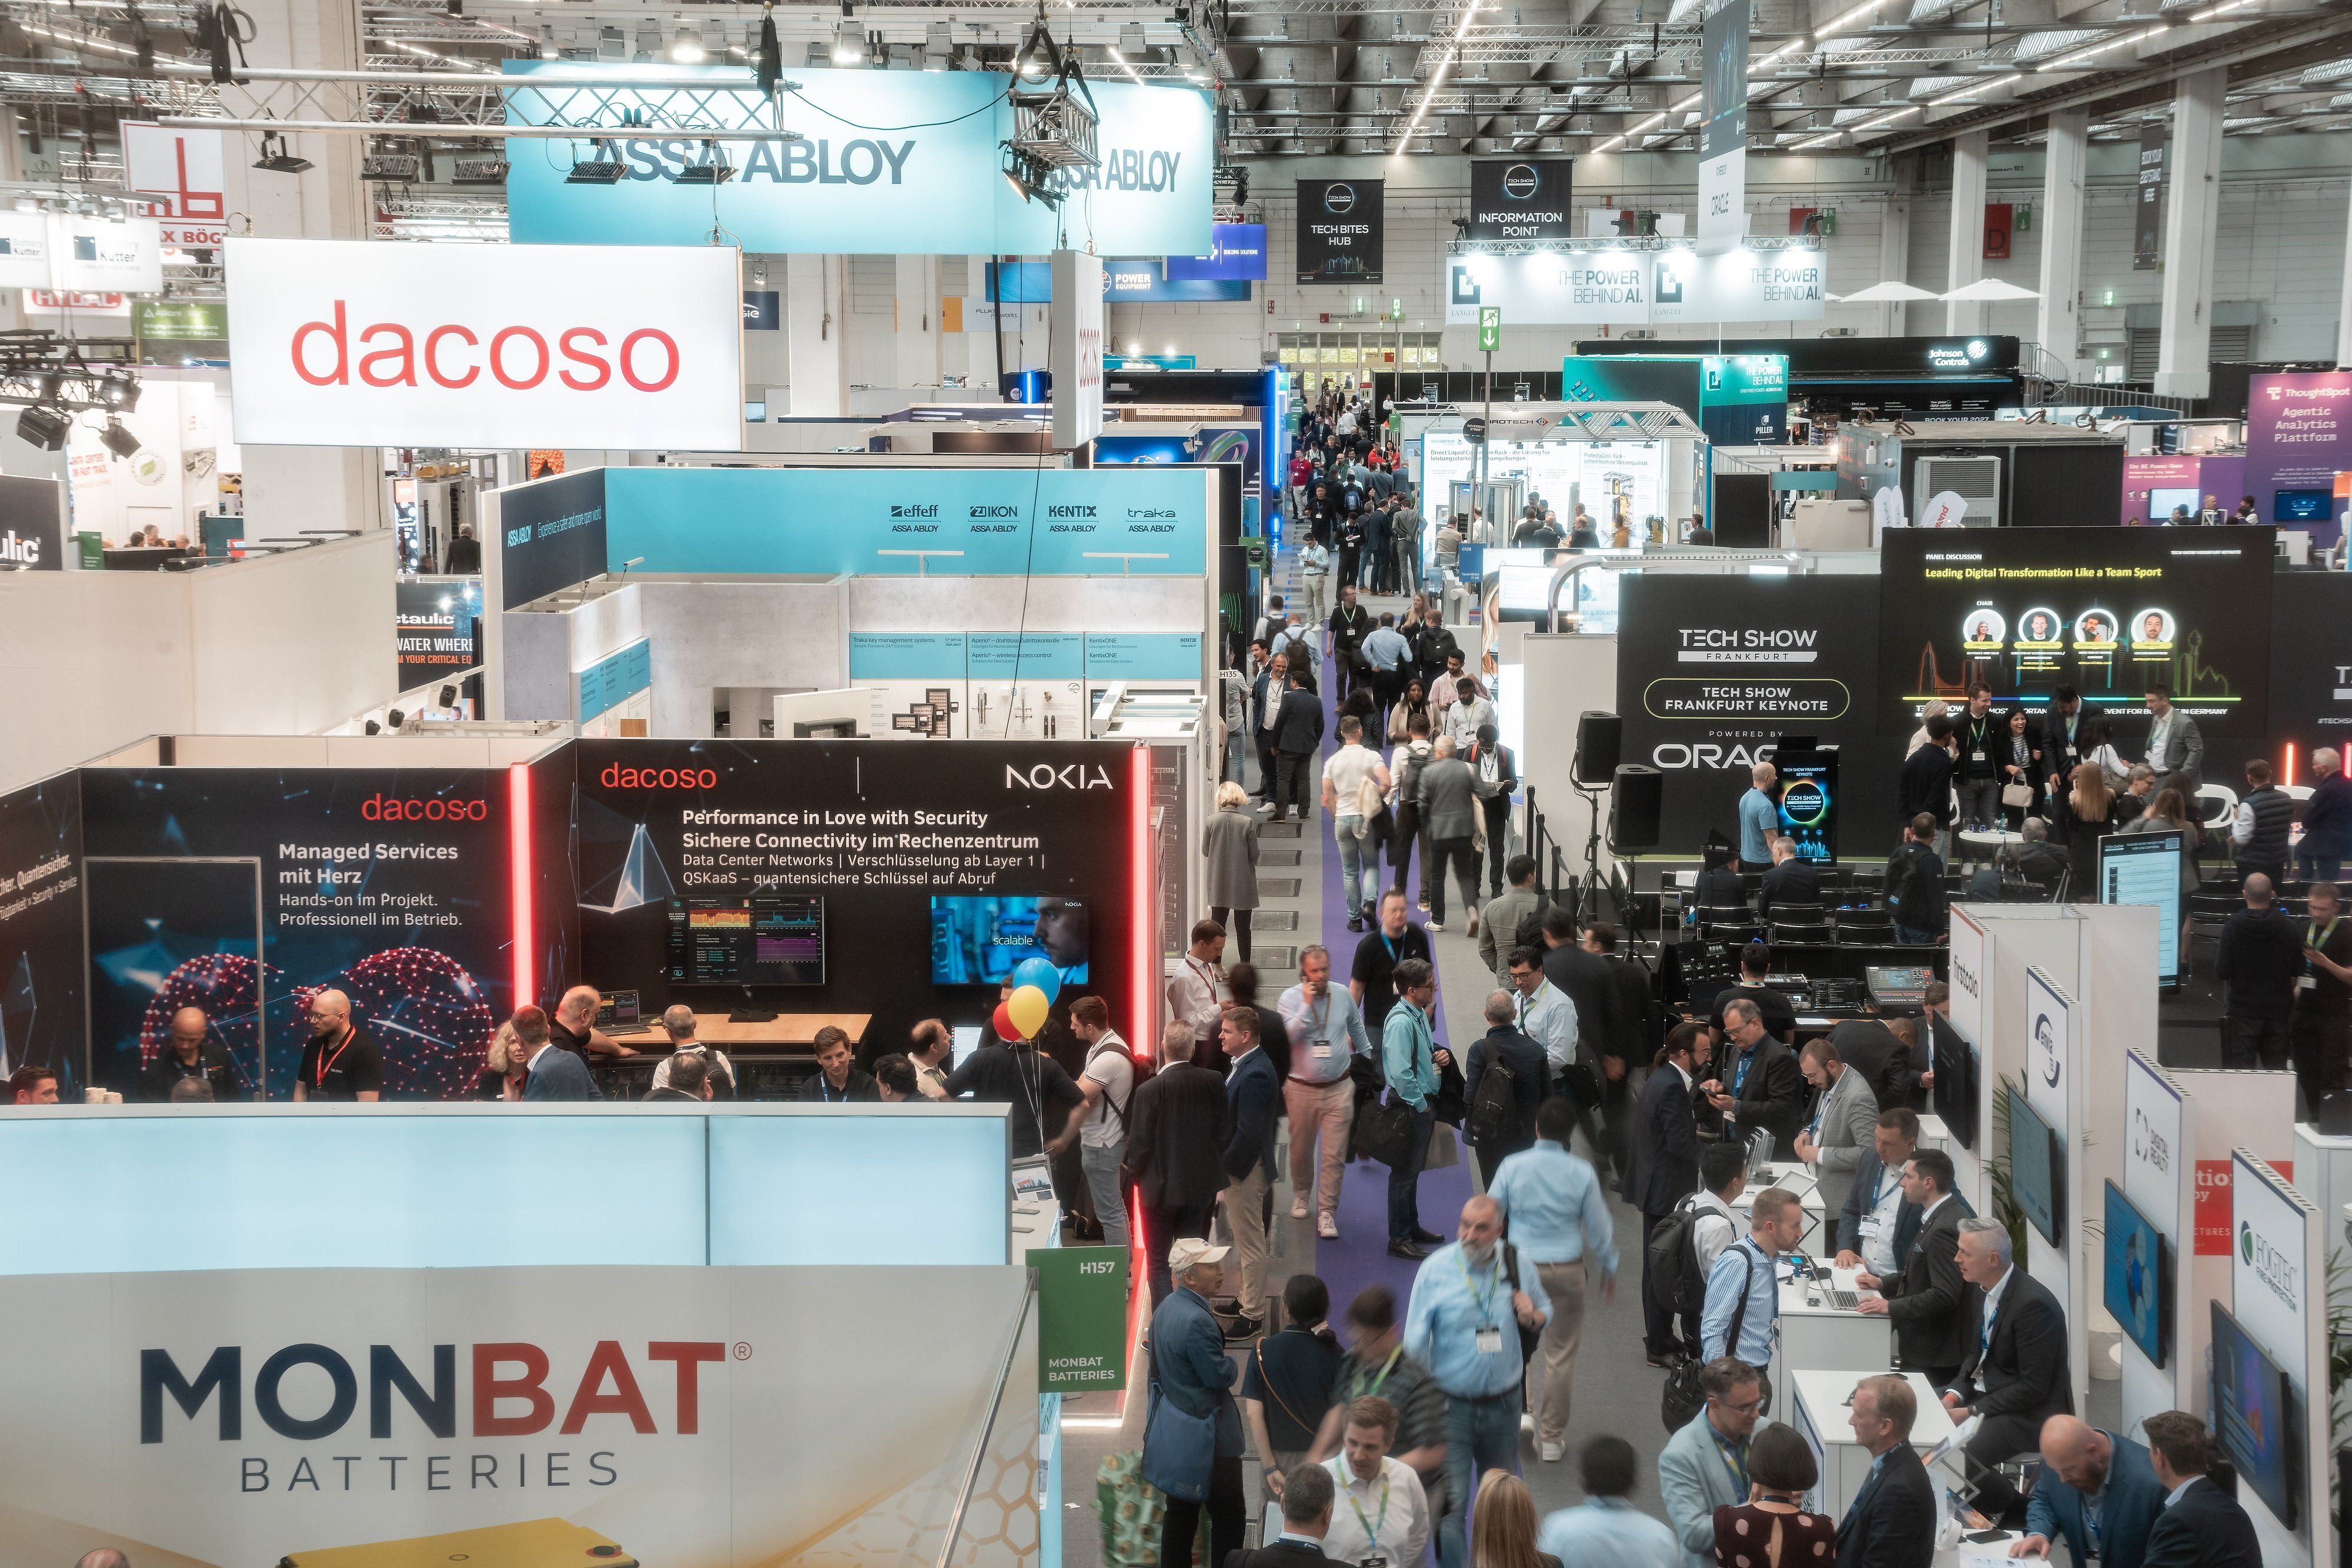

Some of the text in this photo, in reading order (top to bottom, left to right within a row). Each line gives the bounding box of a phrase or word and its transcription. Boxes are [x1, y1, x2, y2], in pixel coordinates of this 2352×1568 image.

[741, 139, 916, 185] ABLOY
[1105, 149, 1181, 192] ABLOY
[1712, 192, 1729, 216] ORACLE
[1479, 212, 1562, 223] INFORMATION
[1311, 225, 1369, 234] TECH BITES
[1503, 226, 1539, 236] POINT
[1329, 237, 1351, 245] HUB
[1988, 229, 2005, 250] D
[100, 252, 136, 262] Kutter
[1115, 273, 1151, 283] POWER
[1558, 270, 1639, 286] THE POWER
[1750, 268, 1818, 283] THE POWER
[1574, 288, 1643, 303] BEHIND AI.
[1765, 286, 1820, 301] BEHIND AI.
[291, 299, 680, 392] dacoso
[1079, 306, 1100, 388] dacoso
[1928, 349, 1963, 358] Johnson
[1935, 357, 1969, 366] Controls
[1745, 366, 1782, 376] THE POWER
[1753, 376, 1775, 385] BEHIND
[2285, 387, 2351, 399] ThoughtSpot
[2283, 407, 2331, 417] Agentic
[1756, 426, 1773, 434] PILLER
[2276, 420, 2337, 430] Analytics
[2274, 433, 2337, 442] Plattform
[904, 505, 939, 517] effeff
[988, 506, 1018, 517] IKON
[1049, 506, 1097, 517] KENTIX
[1128, 508, 1176, 517] traka
[575, 514, 584, 526] more
[584, 511, 593, 526] open
[508, 529, 519, 547] ASSA
[1926, 568, 1963, 579] Leading
[1966, 568, 1996, 579] Digital
[1999, 568, 2073, 577] Transformation
[2075, 568, 2095, 577] Like
[2105, 567, 2132, 577] Team
[2134, 567, 2162, 579] Sport
[1678, 629, 1818, 647] TECH SHOW
[406, 655, 460, 664] YOUR CRITICAL
[1703, 687, 1791, 697] TECH SHOW
[1665, 700, 1828, 711] FRANKFURT KEYNOTE
[601, 763, 717, 788] dacoso
[1007, 764, 1113, 789] NOKIA
[362, 793, 487, 821] dacoso
[683, 809, 988, 828] Performance in Love with Security
[683, 833, 1039, 851] Sichere Connectivity im Rechenzentrum
[279, 843, 458, 863] Managed Services
[684, 854, 1034, 869] Data Center Networks Verschlüsselung ab Layer 1
[279, 868, 362, 884] mit Herz
[683, 872, 997, 886] QSKaaS quantensichere Schlüssel auf Abruf
[280, 893, 438, 909] Hands-on im Projekt.
[280, 912, 463, 925] Professionell im Betrieb.
[994, 935, 1033, 945] scalable
[1954, 954, 1978, 999] firstcolo
[2041, 1030, 2053, 1055] envia
[2150, 1129, 2170, 1159] DIGITAL
[2150, 1147, 2168, 1176] REALTY
[1080, 1262, 1115, 1274] H157
[2256, 1233, 2297, 1298] FOGTEC
[1049, 1357, 1103, 1368] MONBAT
[1049, 1370, 1115, 1381] BATTERIES
[240, 1450, 619, 1493] BATTERIES
